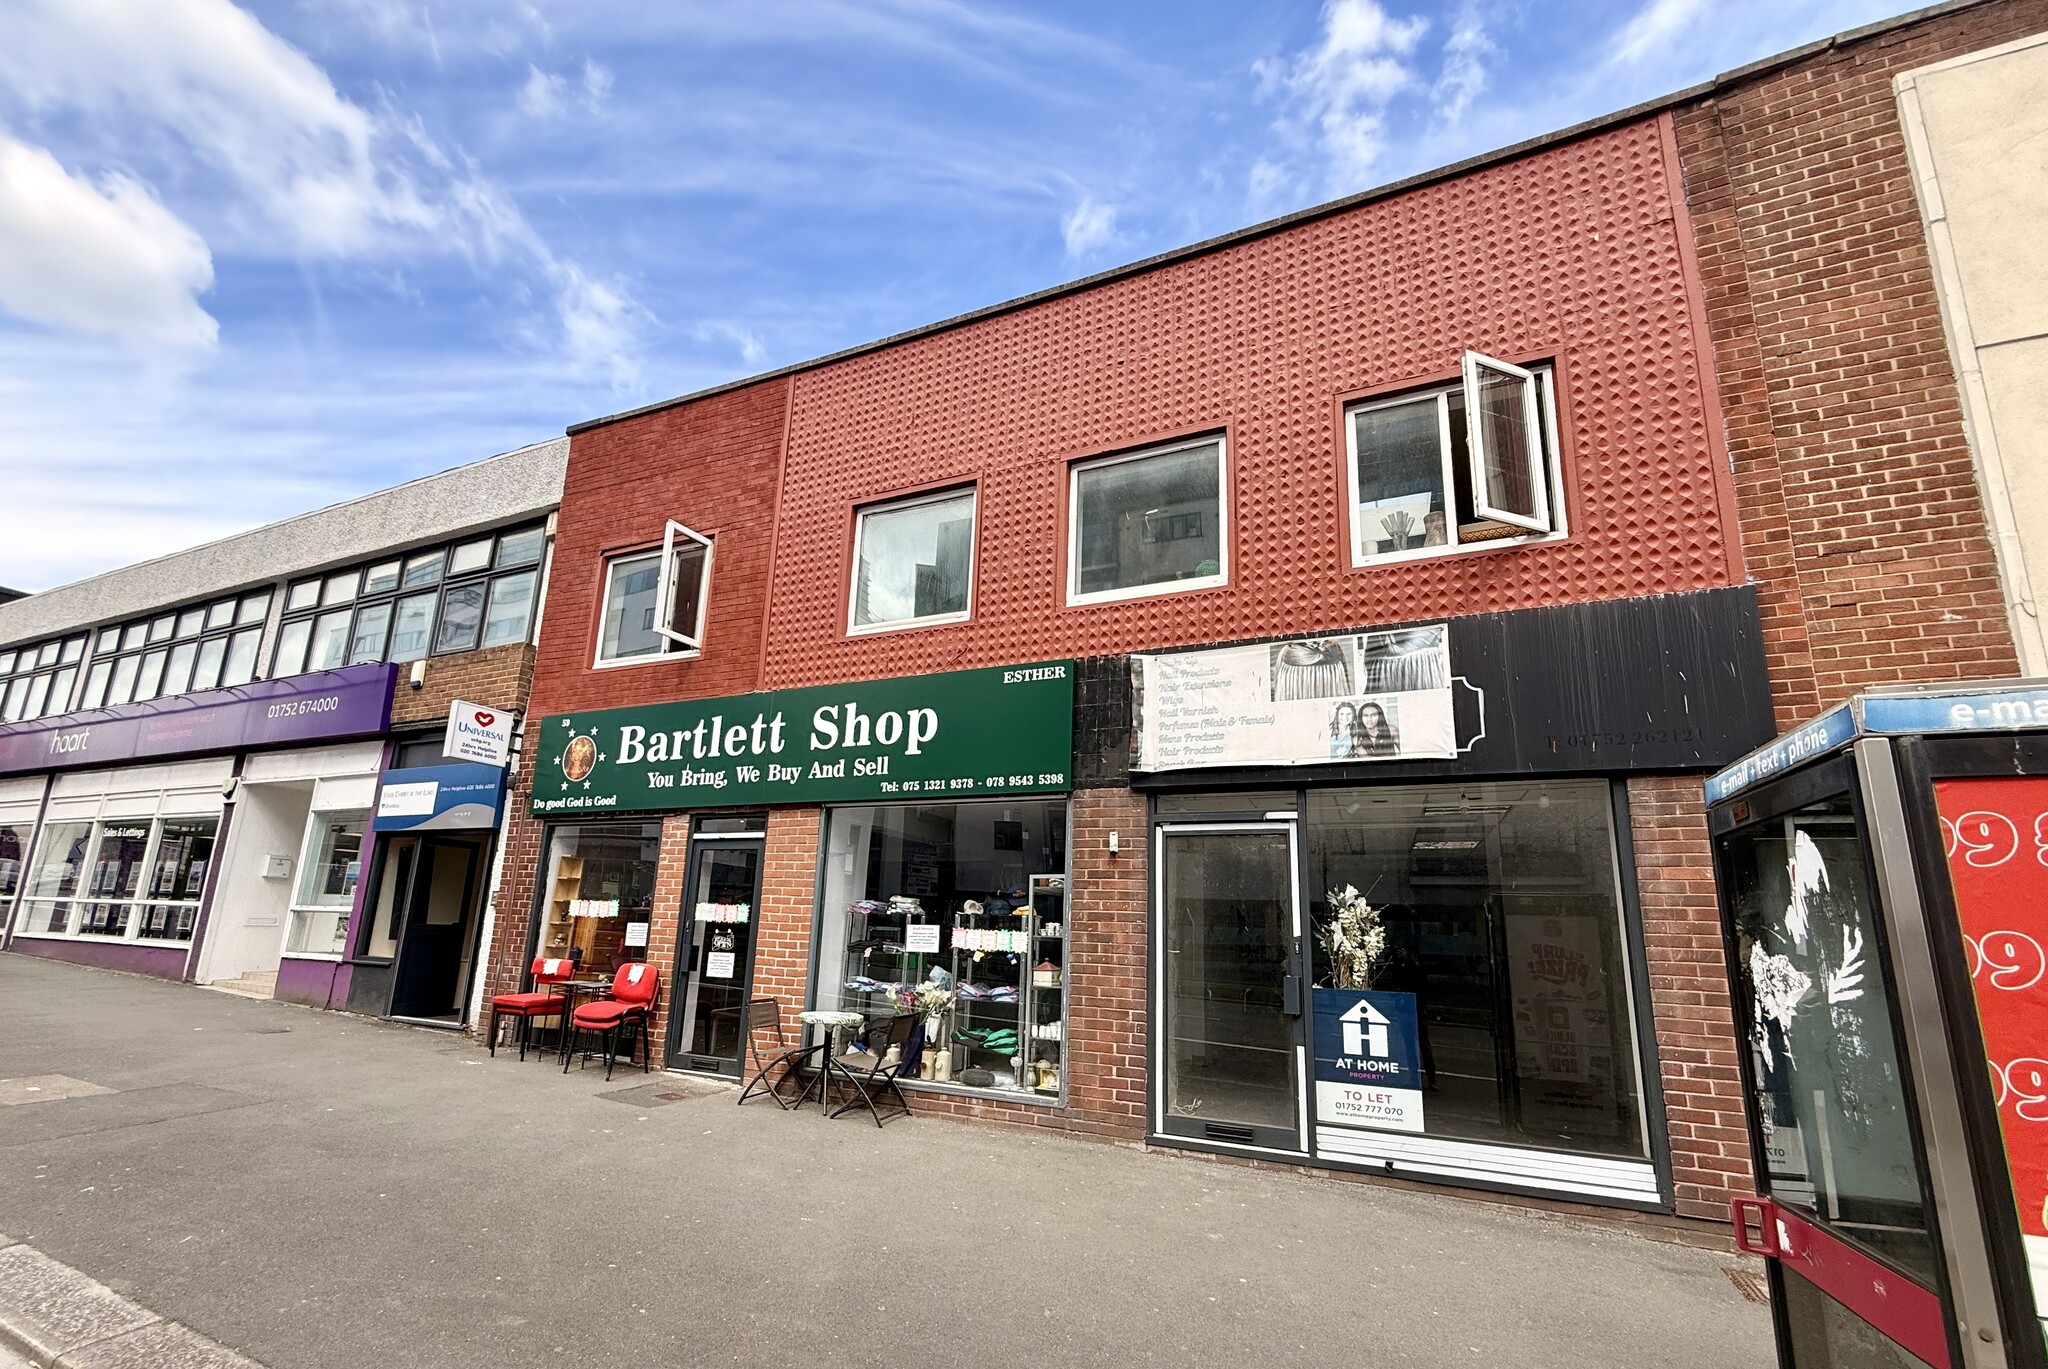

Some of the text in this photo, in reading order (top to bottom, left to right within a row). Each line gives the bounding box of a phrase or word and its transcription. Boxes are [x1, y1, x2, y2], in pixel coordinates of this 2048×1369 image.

[1003, 666, 1066, 684] ESTHER
[1180, 667, 1221, 679] Products
[1182, 679, 1232, 691] Extensions
[268, 696, 339, 718] 01752 674000
[1158, 696, 1184, 707] Wigs
[1180, 705, 1219, 717] Varnish
[458, 721, 504, 741] UNIVERSAL
[1158, 714, 1276, 732] Perfumes (Male & Female)
[50, 727, 91, 754] haart
[616, 702, 938, 765] Bartlett Shop
[1183, 731, 1225, 743] Products
[1568, 733, 1626, 747] 01752
[1632, 728, 1704, 745] 262121
[477, 745, 497, 754] Helpline
[1158, 745, 1224, 757] Hair Products
[1721, 763, 1749, 793] e-mail
[1757, 750, 1779, 775] text
[1788, 728, 1828, 764] phone
[647, 756, 889, 788] You Bring, We Buy And Sell
[880, 781, 899, 792] Tel:
[902, 781, 920, 791] 075
[924, 779, 946, 790] 1321
[950, 778, 973, 789] 9378
[986, 776, 1004, 787] 078
[1008, 775, 1034, 786] 9543
[1038, 773, 1064, 785] 5398
[533, 794, 617, 811] Do good God is Good
[103, 827, 145, 839] Sales & Lettings
[1336, 1057, 1399, 1074] AT HOME
[1349, 1072, 1385, 1080] PROPERTY
[1344, 1090, 1392, 1105] TO LET
[1335, 1101, 1403, 1116] 01752 777 070
